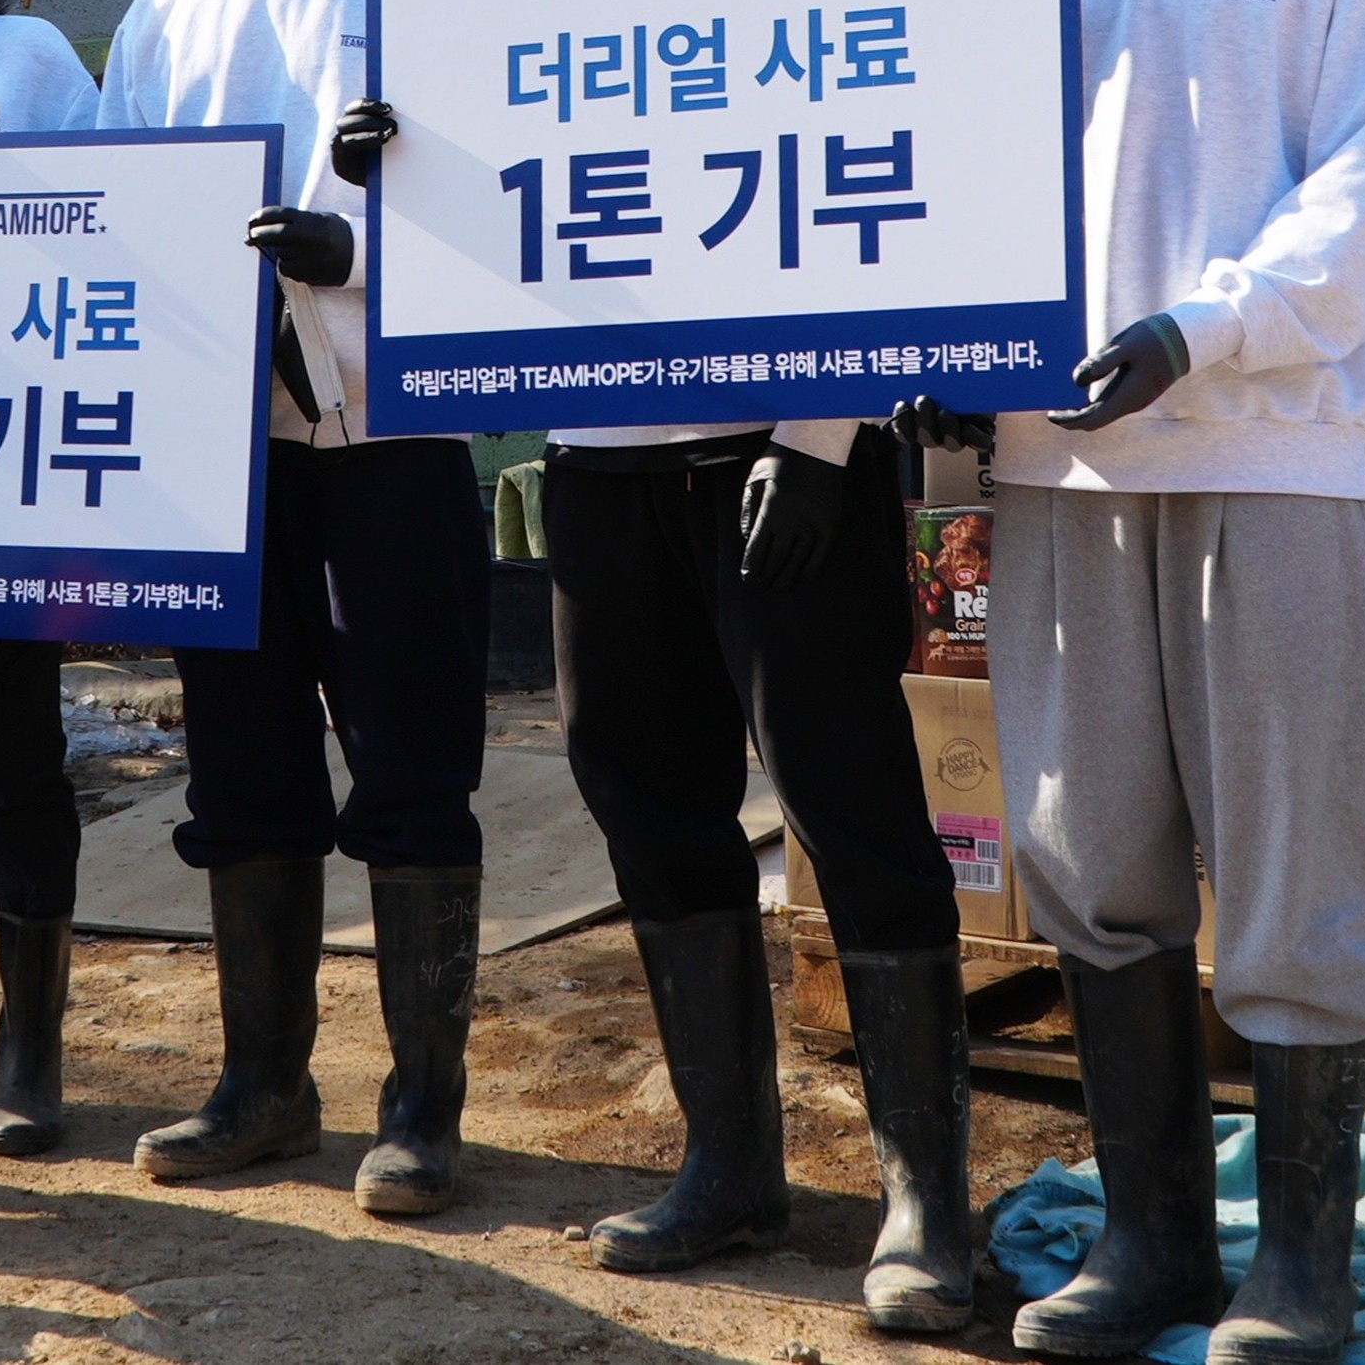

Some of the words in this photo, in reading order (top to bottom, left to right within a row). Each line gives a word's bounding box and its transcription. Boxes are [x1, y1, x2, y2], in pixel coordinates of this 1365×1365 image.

[507, 16, 728, 123] 더리얼
[755, 6, 917, 102] 사료
[499, 149, 663, 284] 1톤
[699, 130, 927, 270] 기부
[11, 277, 141, 360] 사료
[402, 366, 517, 397] 하림더리얼과
[520, 358, 665, 389] TEAMHOPE가
[667, 353, 771, 386] 유기동물을
[774, 350, 818, 381] 위해
[821, 349, 865, 377] 사료
[868, 345, 923, 376] 1톤을
[926, 339, 1044, 373] 기부합니다.
[11, 579, 45, 605] 위해
[48, 580, 83, 605] 사료
[85, 581, 130, 608] 1톤을
[132, 582, 224, 611] 기부합니다.
[946, 750, 976, 765] HAPPY
[947, 760, 979, 775] DANCE
